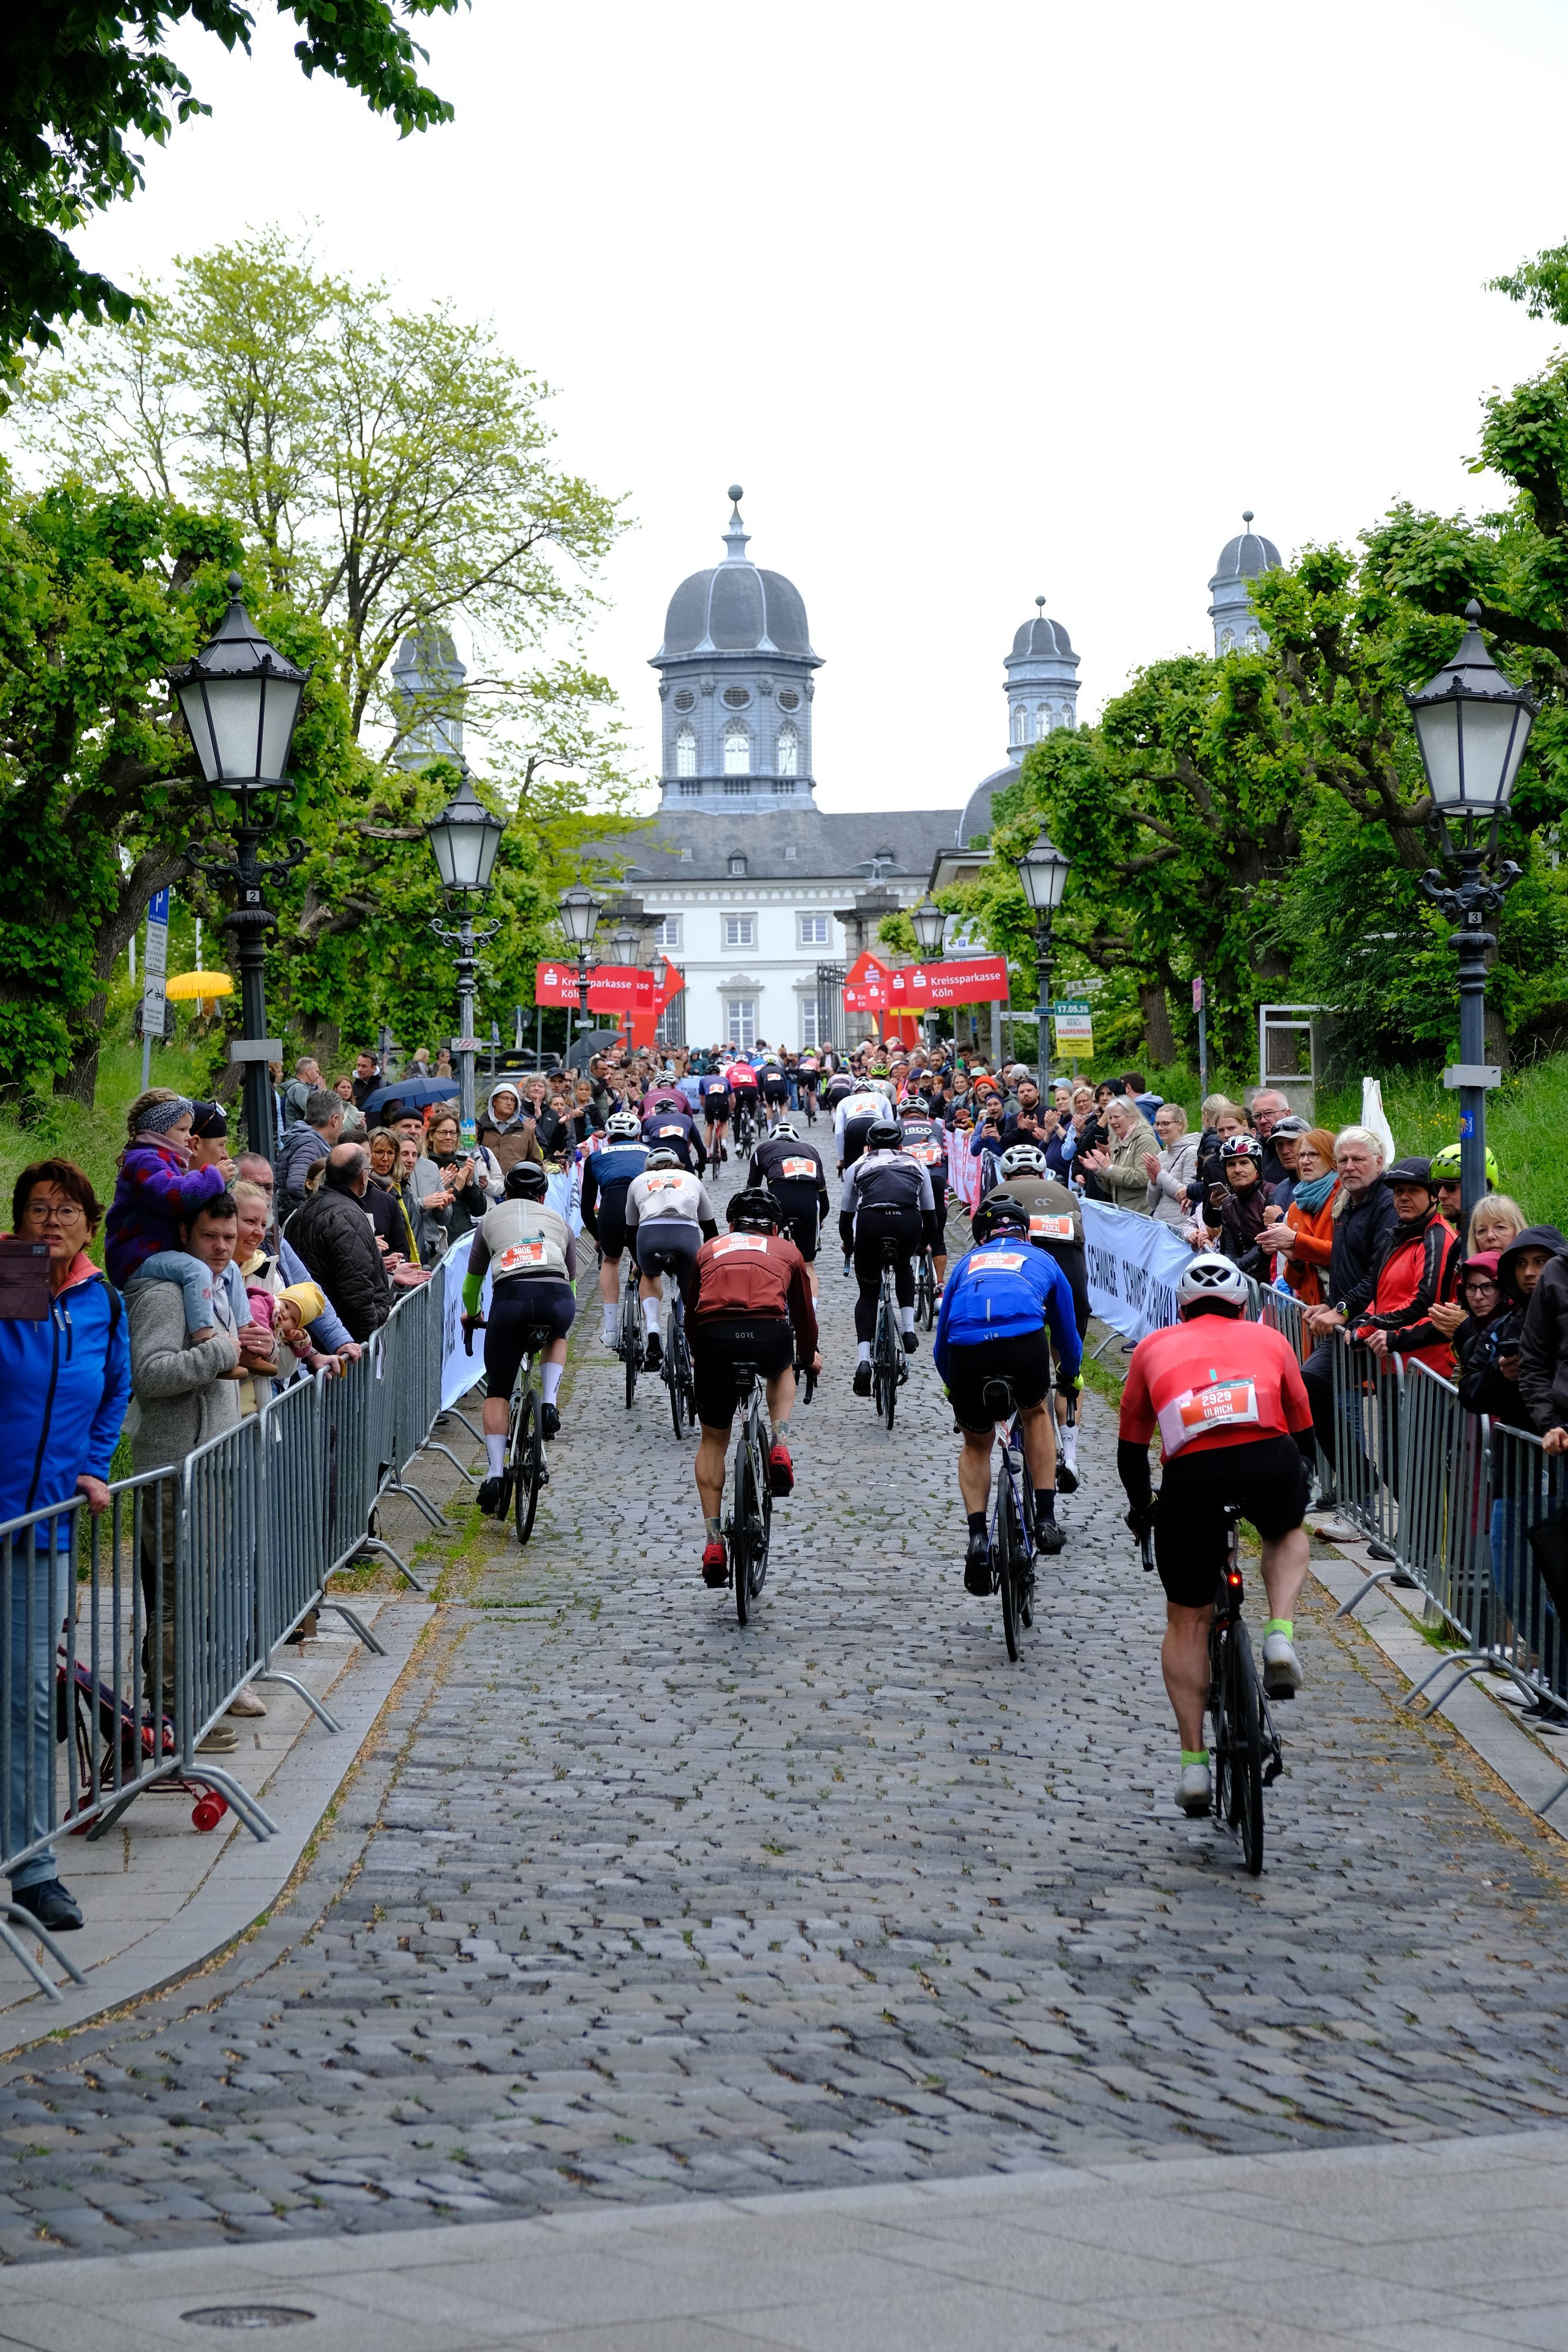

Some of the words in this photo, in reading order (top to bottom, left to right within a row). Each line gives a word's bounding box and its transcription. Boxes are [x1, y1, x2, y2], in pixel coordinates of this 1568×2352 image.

[250, 891, 256, 900] 2
[1472, 913, 1478, 922] 3
[931, 972, 1001, 986] Kreissparkasse
[932, 987, 953, 998] Köln
[1042, 1224, 1061, 1232] PASCAL
[513, 1254, 534, 1264] PATRICK
[1202, 1391, 1232, 1407] 2929
[1204, 1404, 1233, 1419] ULRICH
[1207, 1416, 1232, 1427] SCHWALBE
